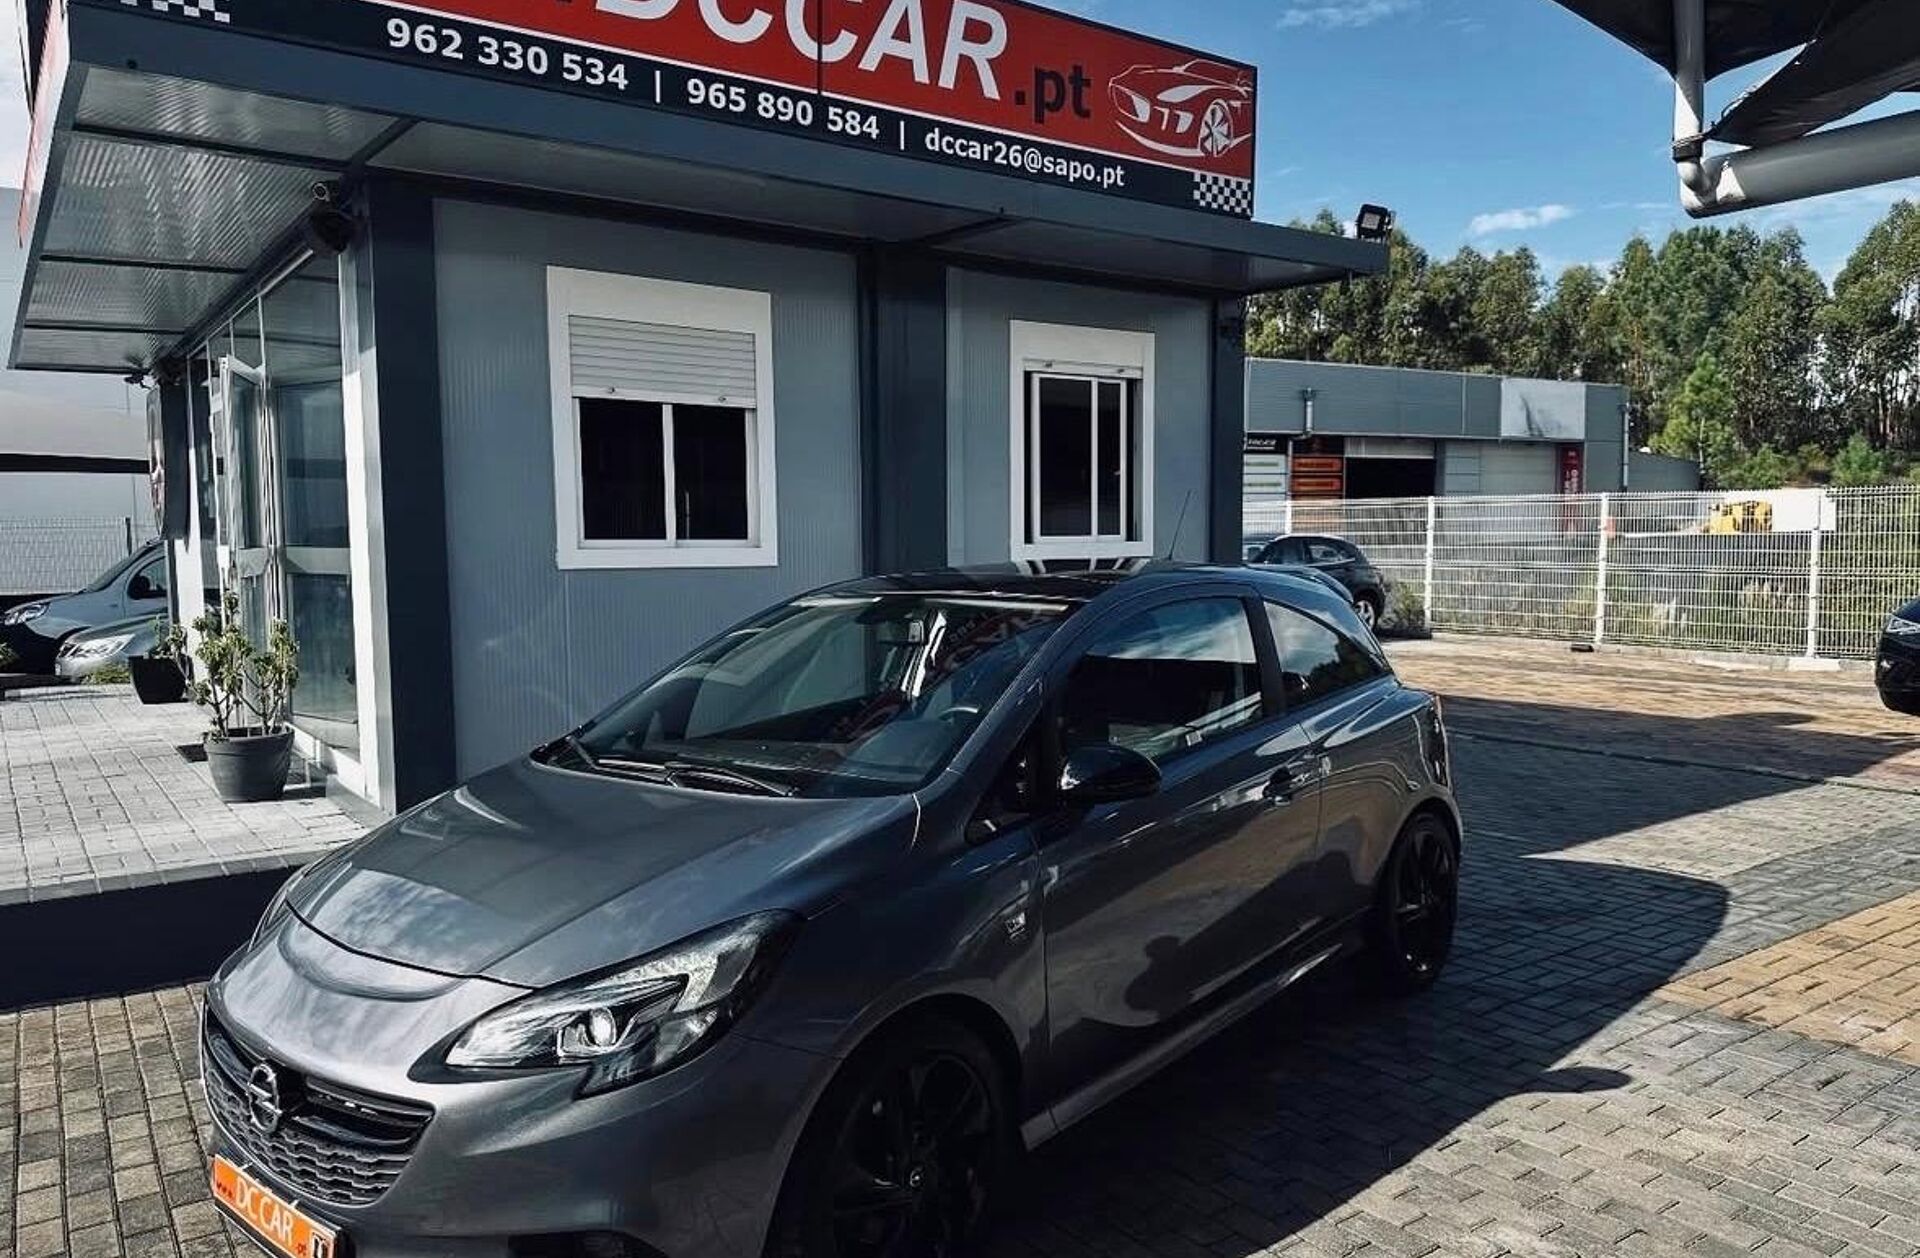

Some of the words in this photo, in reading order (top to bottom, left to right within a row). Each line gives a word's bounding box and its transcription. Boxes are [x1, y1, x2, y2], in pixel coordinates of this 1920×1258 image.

[386, 18, 464, 60] 962
[478, 36, 548, 75] 330
[562, 53, 629, 90] 534
[686, 78, 747, 112] 965
[756, 92, 813, 126] 890
[827, 106, 880, 139] 584
[924, 128, 1125, 188] dccar26@sapo.pt
[595, 0, 1007, 101] CAR
